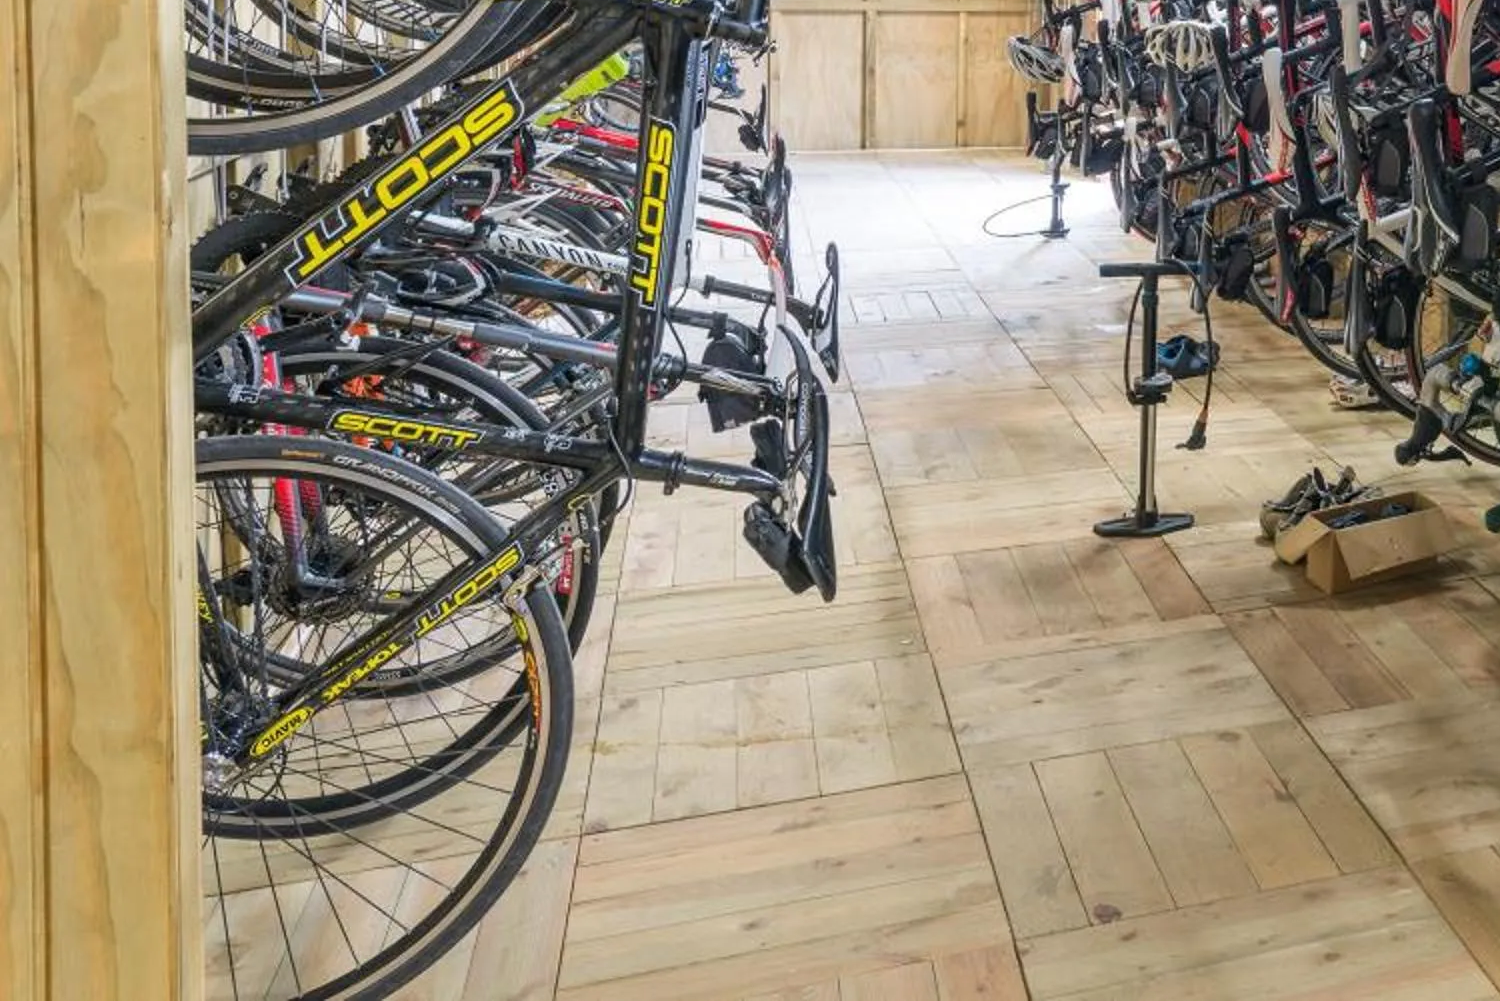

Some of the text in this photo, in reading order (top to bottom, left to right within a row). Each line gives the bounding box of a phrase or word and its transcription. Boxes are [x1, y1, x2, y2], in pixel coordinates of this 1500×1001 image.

[296, 87, 519, 279] SCOTT
[634, 123, 675, 303] SCOTT
[498, 234, 603, 267] CANYON
[331, 410, 482, 449] SCOTT
[415, 546, 523, 639] SCOTT
[321, 642, 404, 703] TOPEAK
[261, 713, 302, 749] MAVIC
